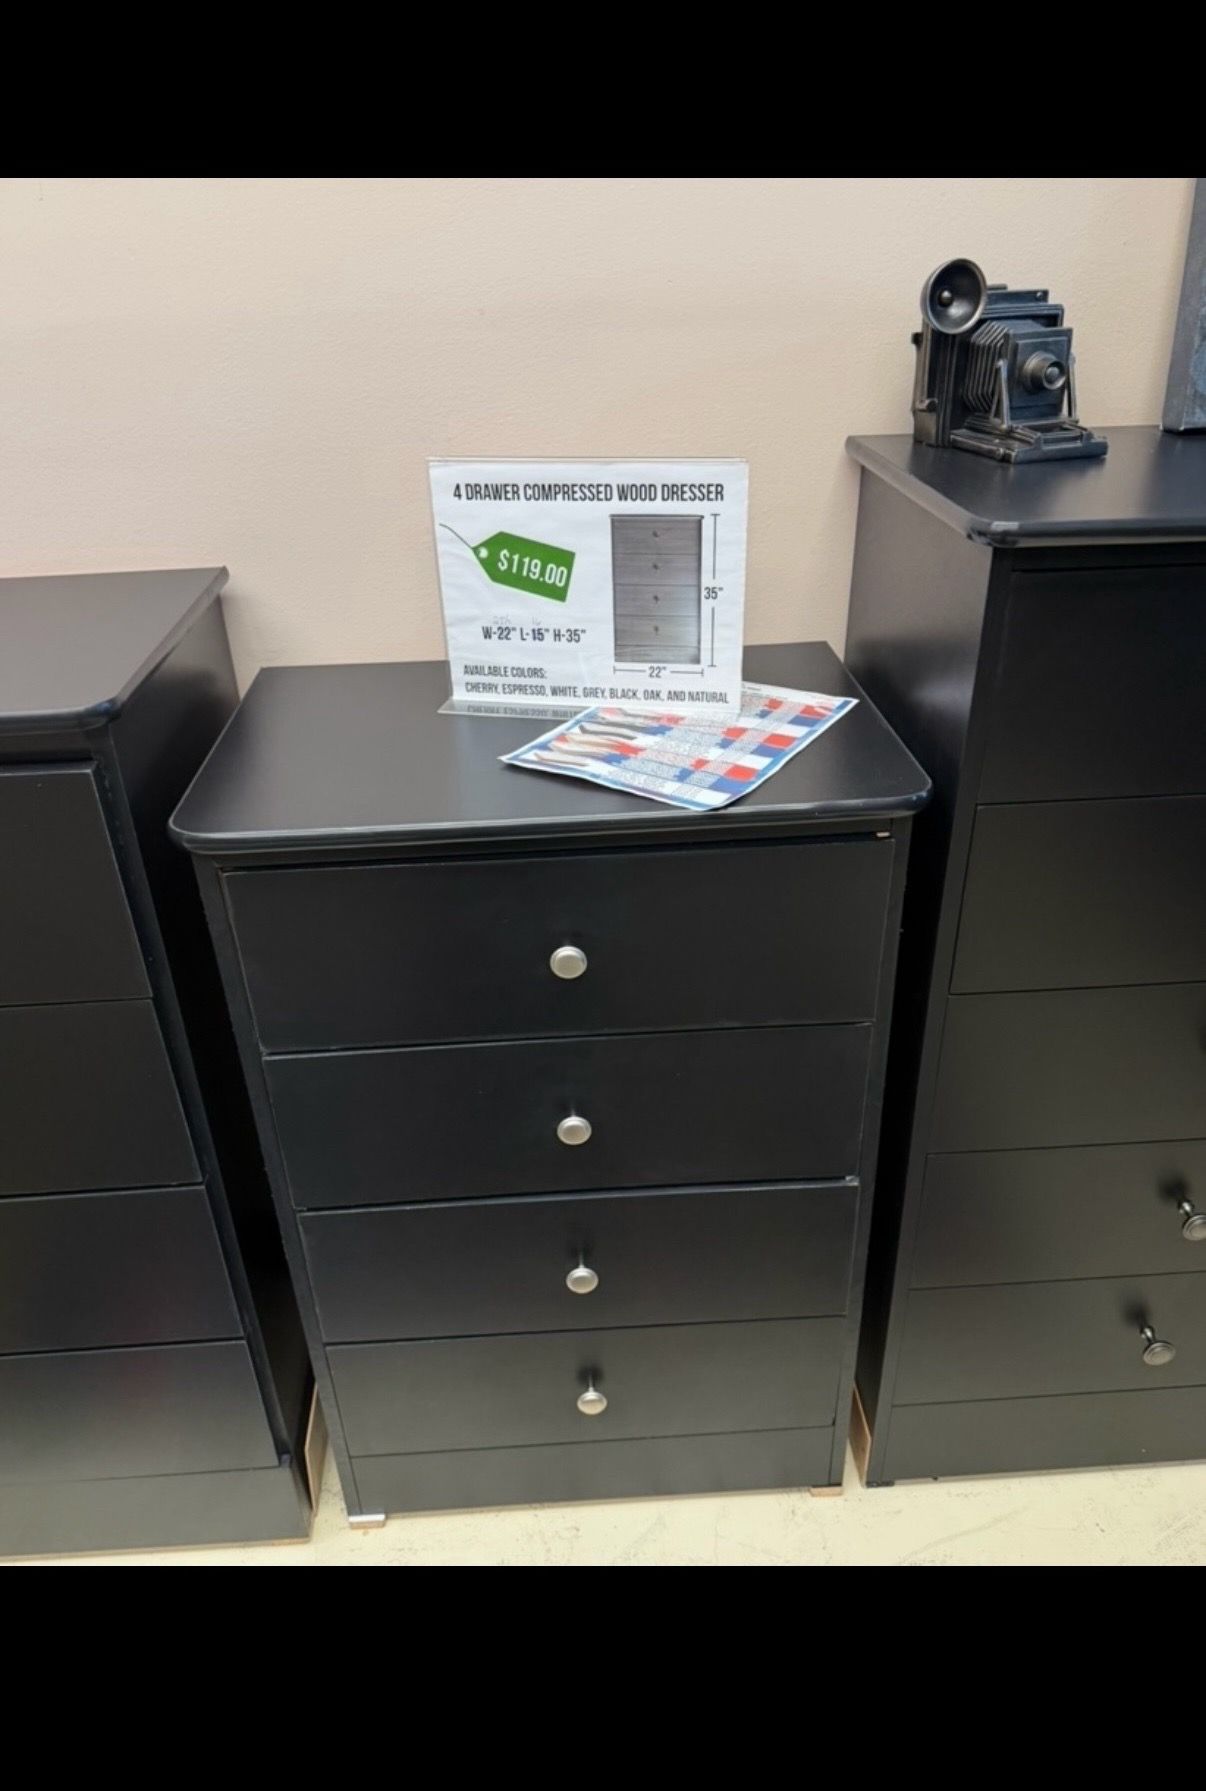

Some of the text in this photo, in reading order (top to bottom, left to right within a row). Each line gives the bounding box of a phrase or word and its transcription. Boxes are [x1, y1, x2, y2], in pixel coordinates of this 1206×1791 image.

[453, 483, 724, 501] 4 DRAWER COMPRESSED WOOD DRESSER
[497, 549, 568, 587] $119.00
[704, 586, 723, 600] 35"
[481, 626, 517, 641] W-22"
[553, 628, 587, 643] H-35"
[463, 664, 547, 679] AVAILABLE COLORS:
[648, 666, 667, 678] 22"
[465, 682, 729, 704] CHERRY, ESPRESSO, WHITE, GREY, BLACK, OAK, AND NATURAL
